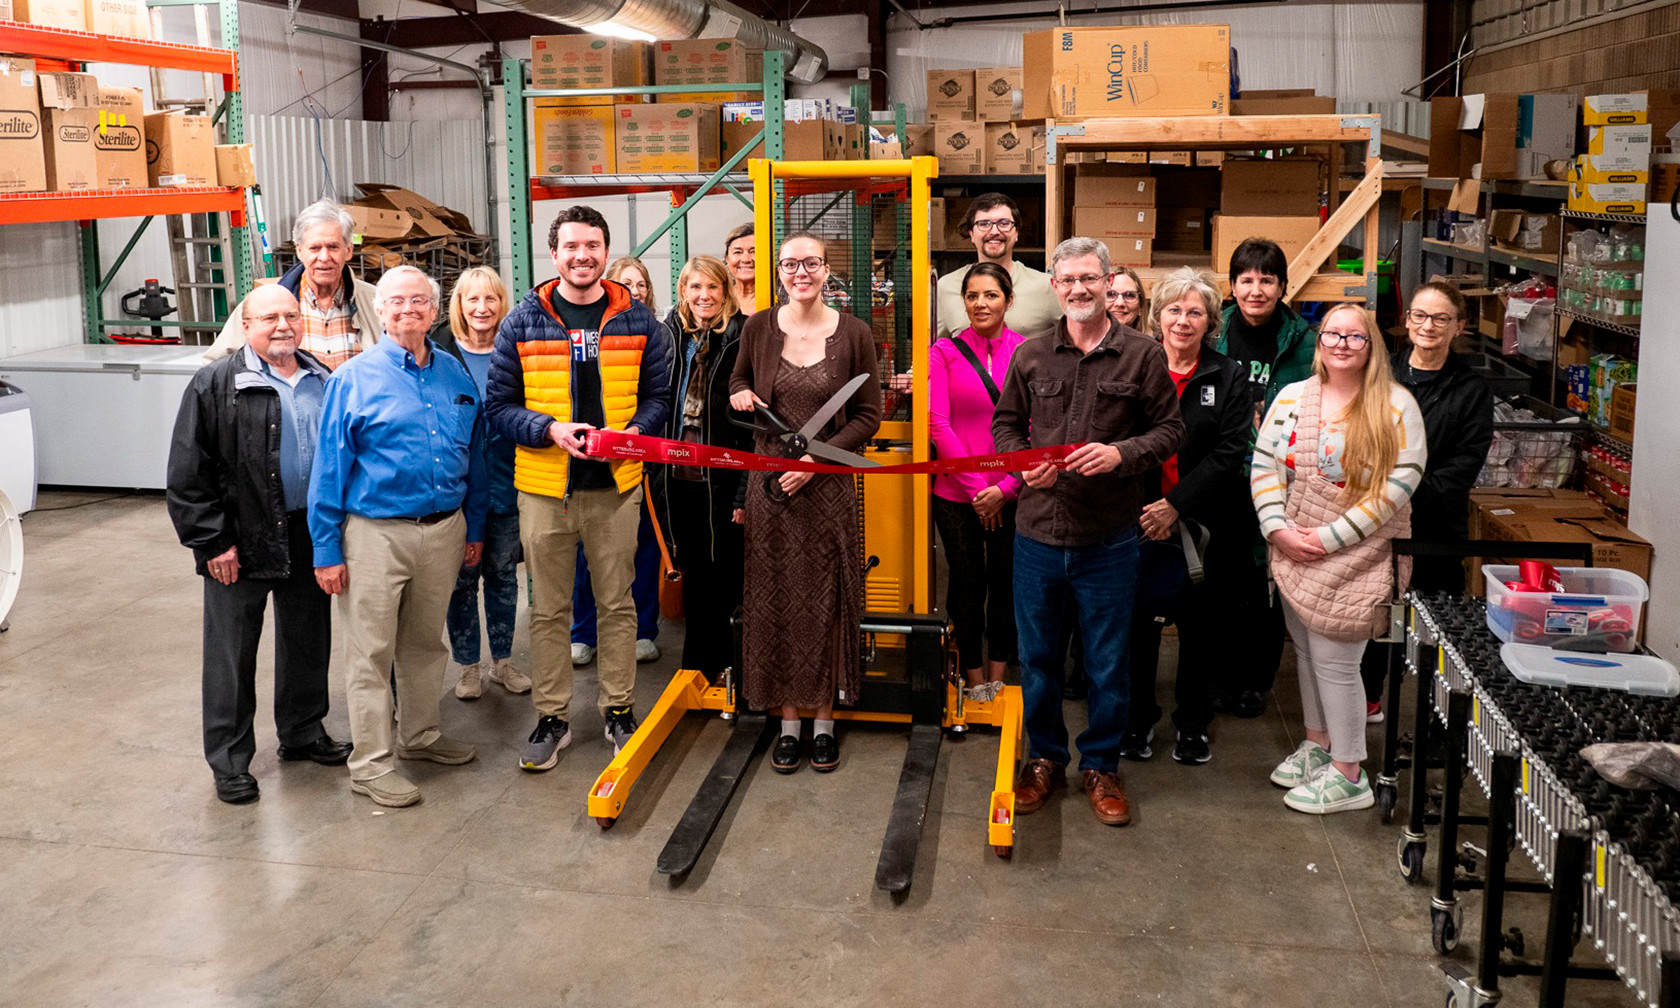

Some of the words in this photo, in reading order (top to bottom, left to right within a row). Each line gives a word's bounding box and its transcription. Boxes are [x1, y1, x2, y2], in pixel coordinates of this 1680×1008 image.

[1062, 32, 1073, 51] F8M
[1107, 44, 1125, 101] WinCup
[63, 129, 88, 140] Sterilite
[99, 132, 136, 146] Sterilite
[585, 331, 599, 344] WES
[587, 344, 598, 358] HO
[667, 448, 690, 458] mpix
